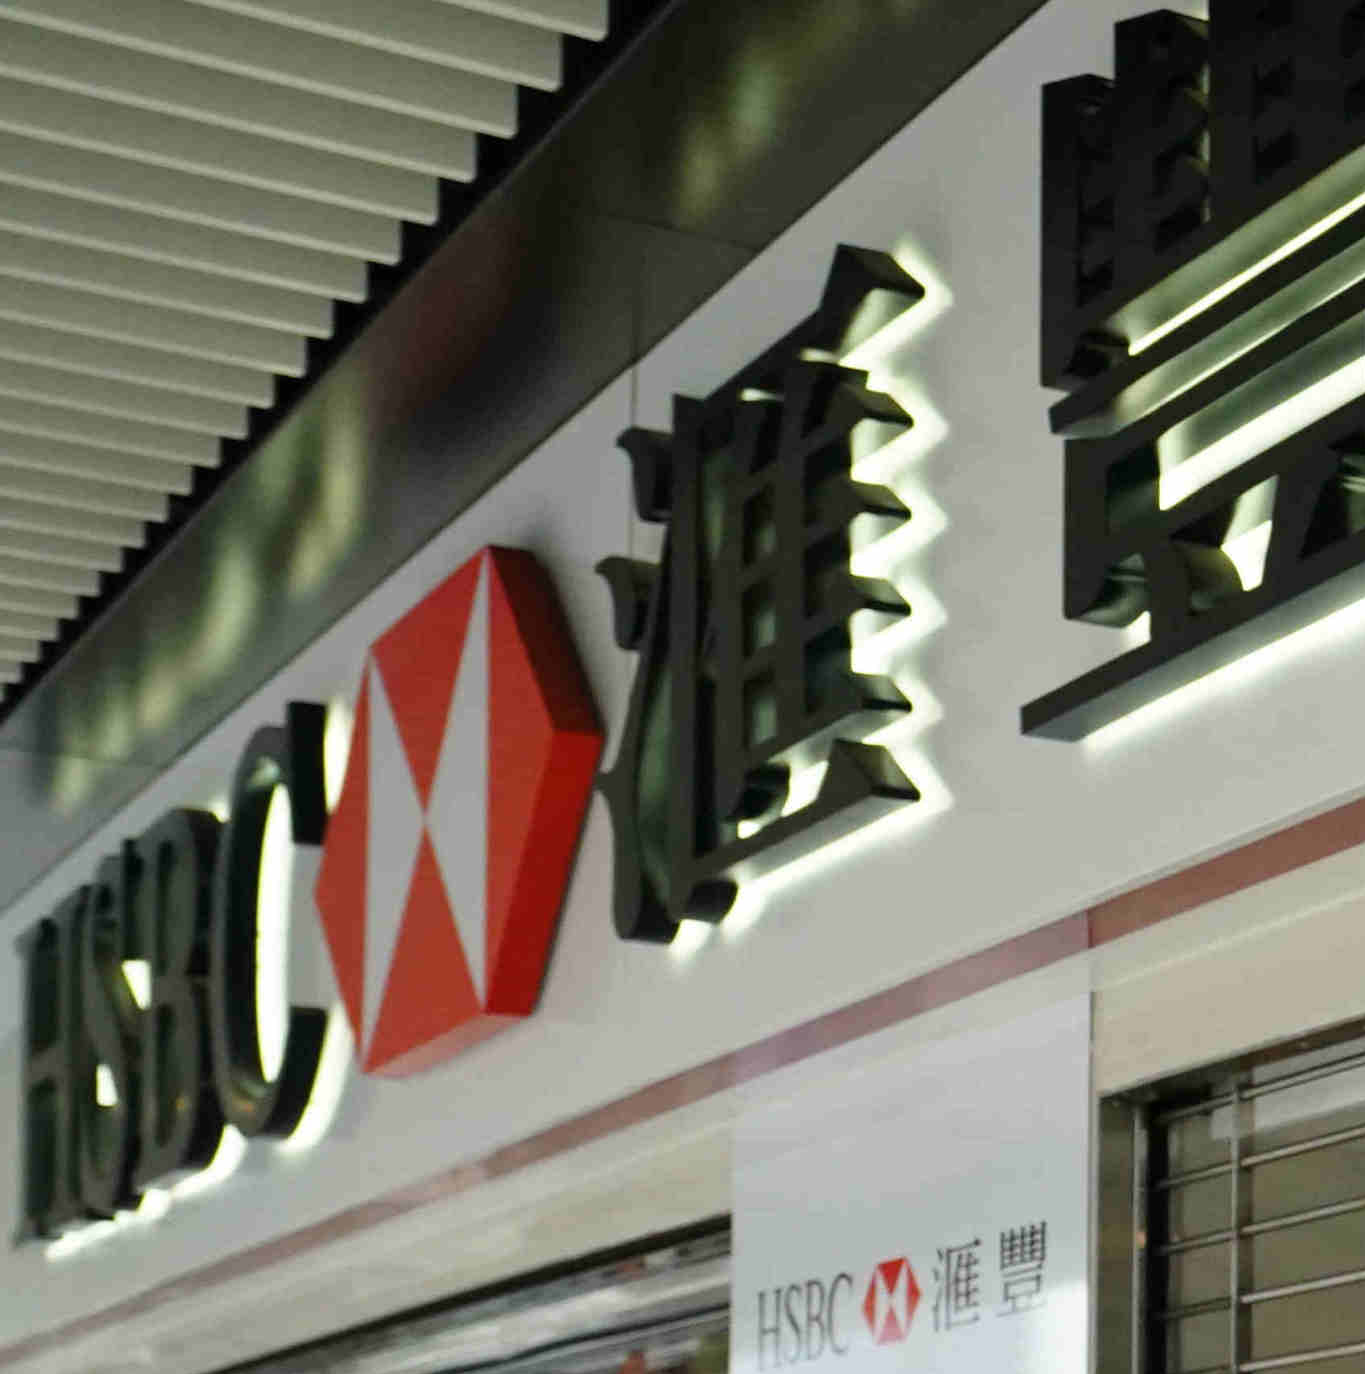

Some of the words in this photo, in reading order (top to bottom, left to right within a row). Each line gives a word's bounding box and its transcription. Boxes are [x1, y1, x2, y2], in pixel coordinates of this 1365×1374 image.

[13, 700, 328, 1242] HSBC
[756, 1273, 854, 1372] HSBC
[931, 1221, 1048, 1333] 滙豐
